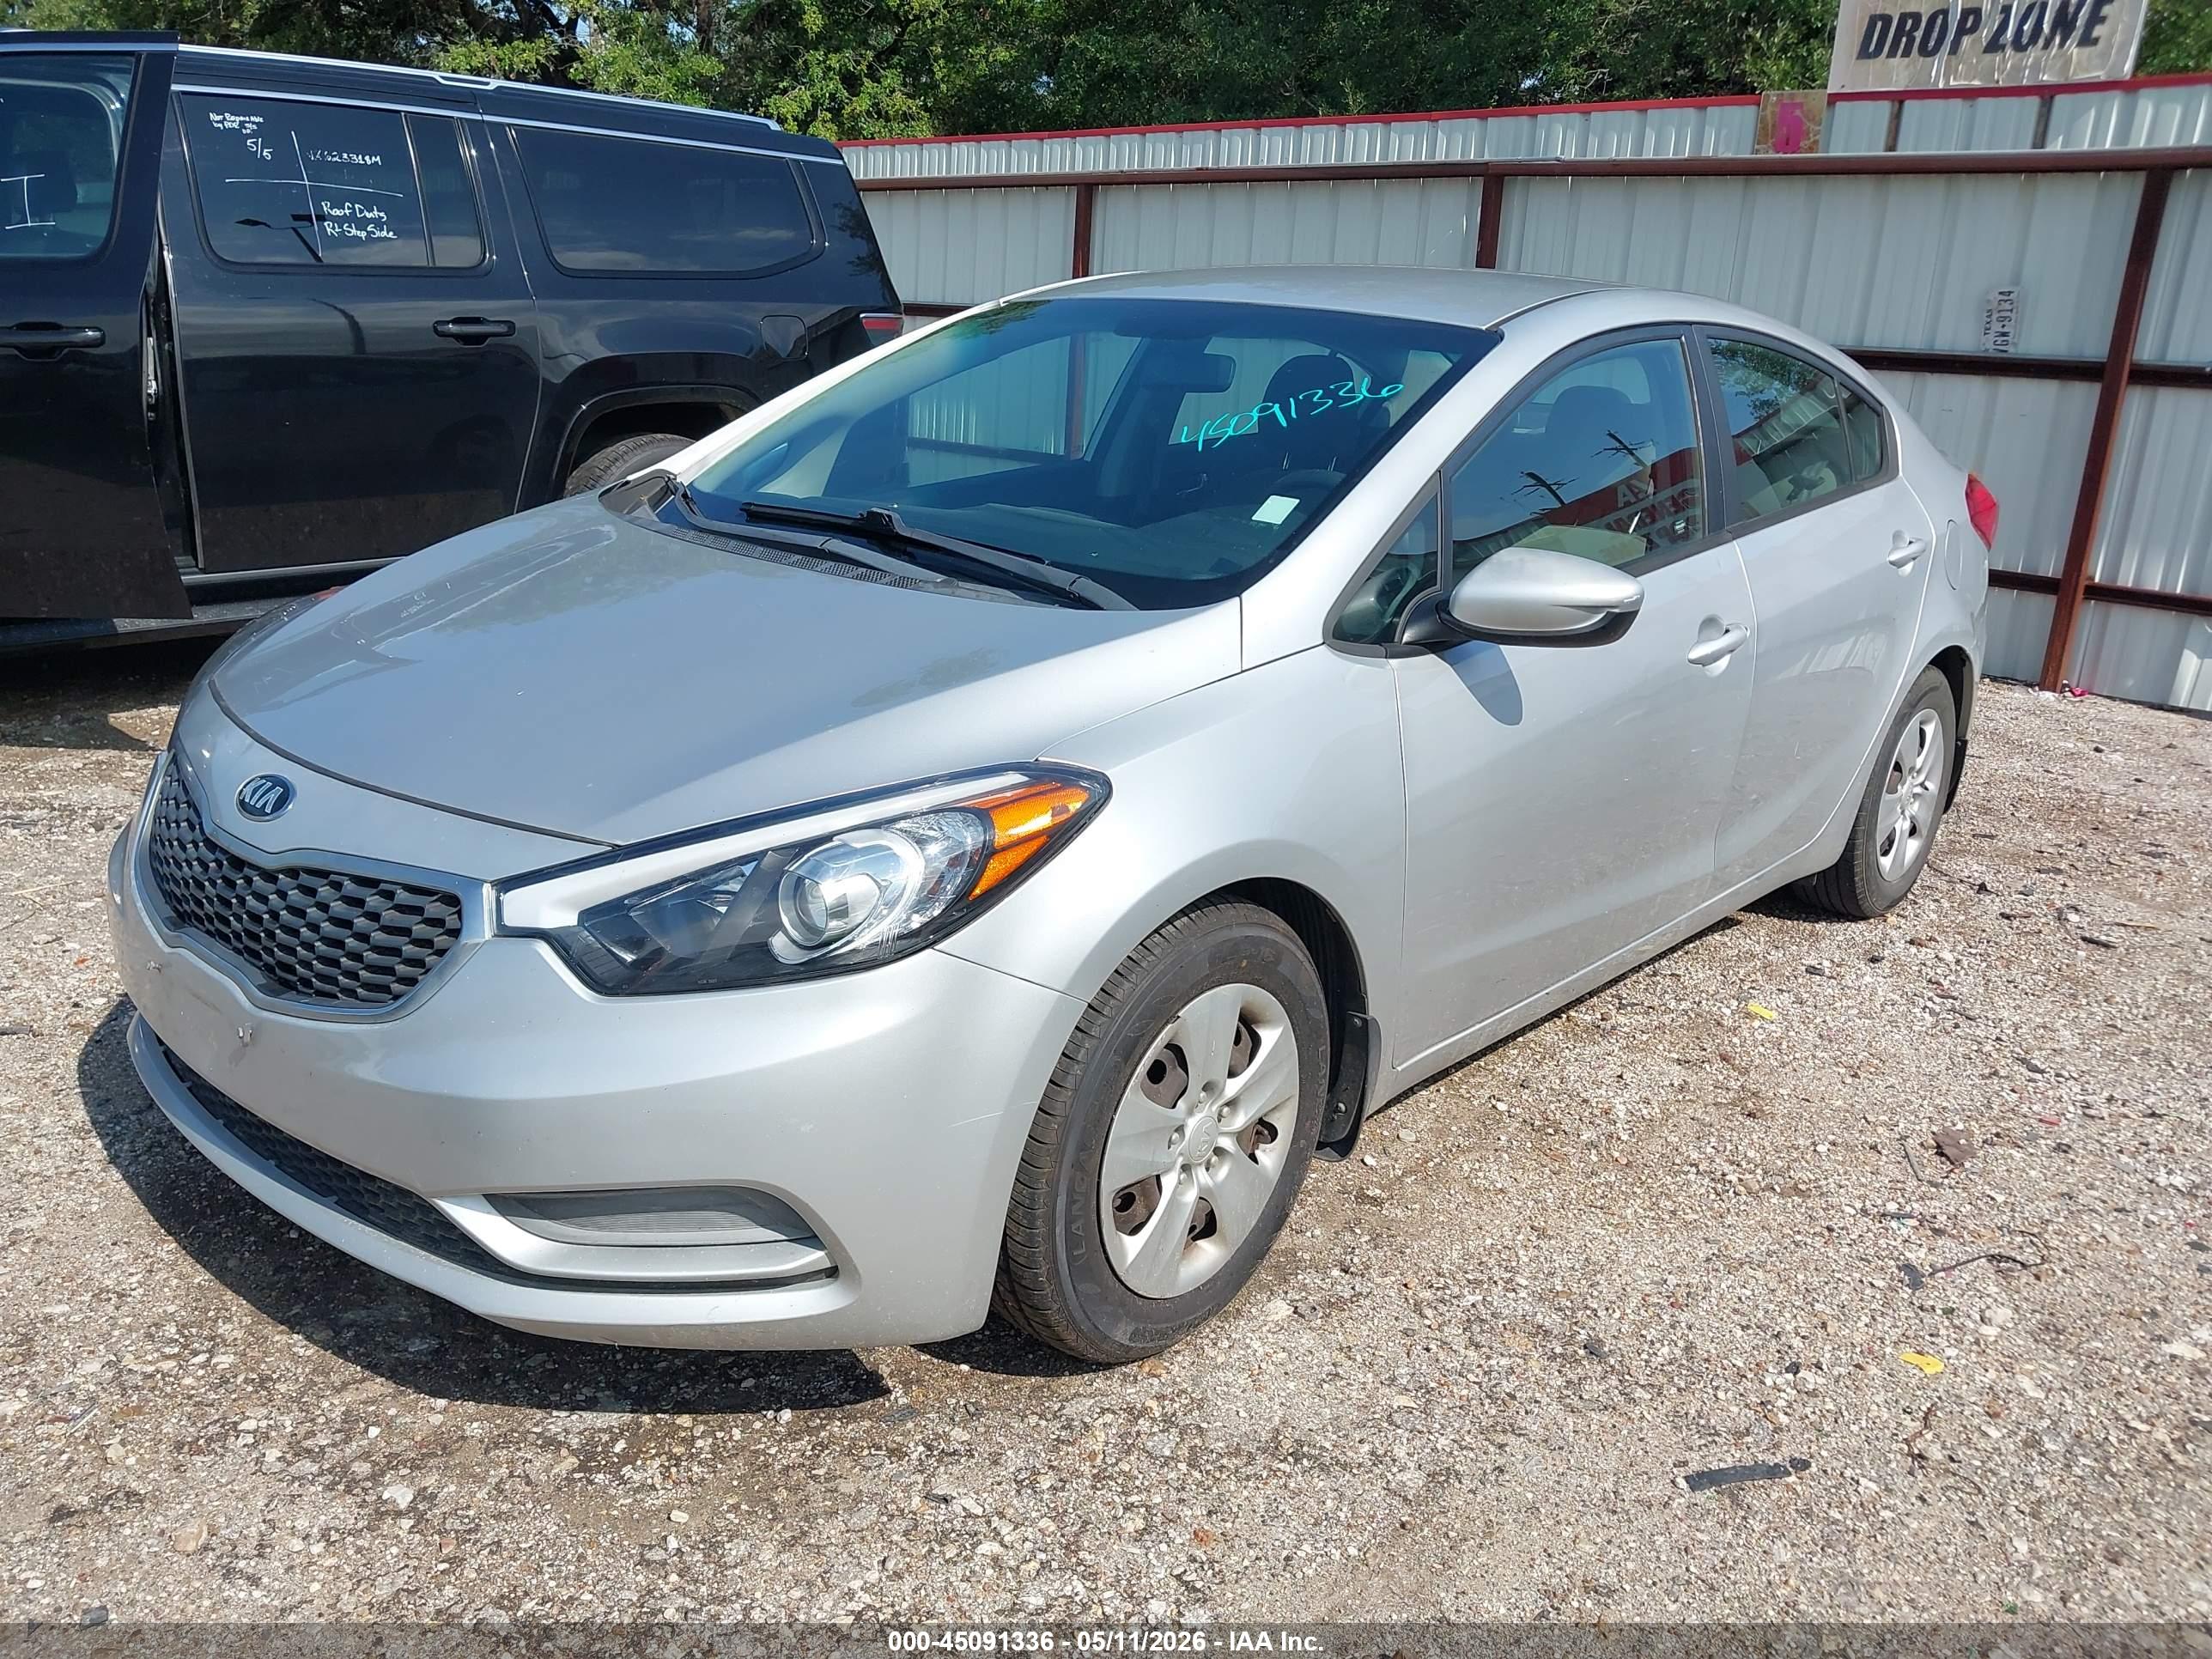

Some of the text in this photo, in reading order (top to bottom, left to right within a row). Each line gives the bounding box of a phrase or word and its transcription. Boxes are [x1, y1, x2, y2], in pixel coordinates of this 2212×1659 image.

[1856, 0, 2115, 60] DROP ZONE
[223, 121, 240, 130] PDR
[246, 137, 274, 161] 5/5
[321, 200, 387, 222] Roof Dents
[343, 222, 368, 241] Step
[367, 224, 398, 239] Side
[1983, 309, 1993, 337] TEXAS
[1181, 377, 1406, 453] 45091336
[239, 777, 284, 814] KIA
